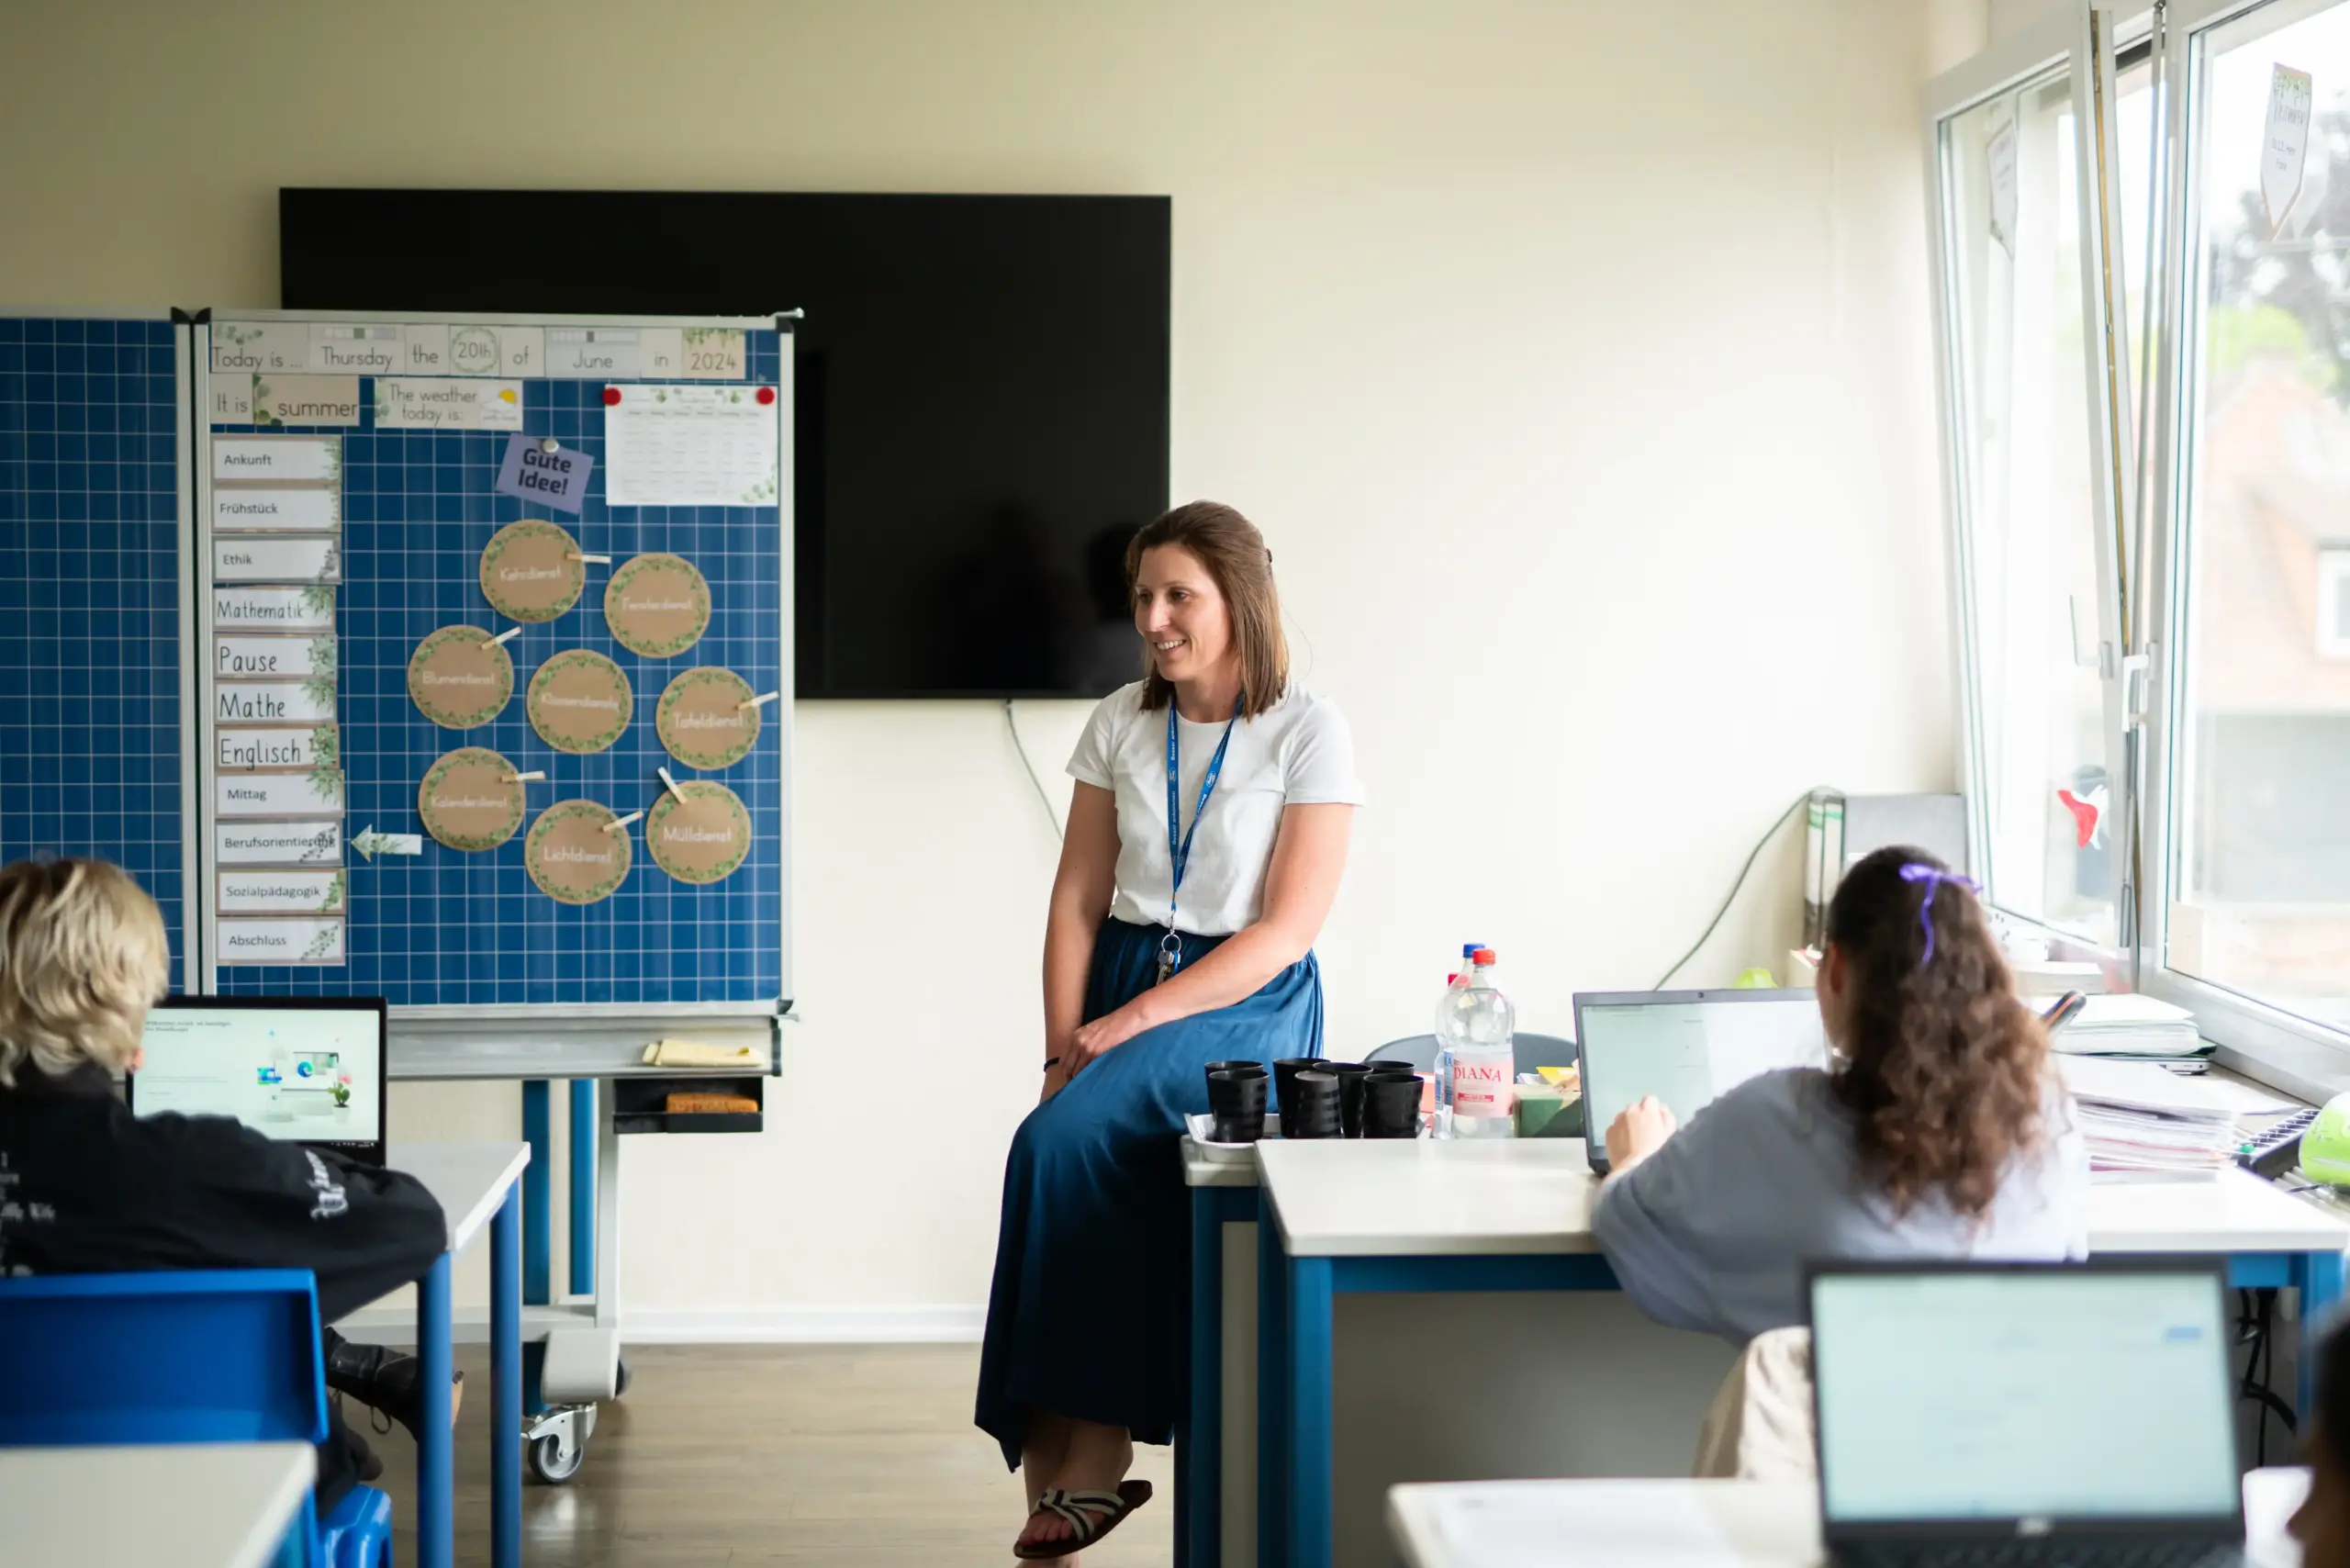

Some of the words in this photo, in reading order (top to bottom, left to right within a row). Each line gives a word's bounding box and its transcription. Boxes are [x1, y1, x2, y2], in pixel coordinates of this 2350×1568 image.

[213, 346, 263, 373] Today
[270, 351, 284, 367] is
[321, 346, 393, 372] Thursday
[412, 347, 439, 364] the
[457, 342, 492, 359] 20th
[512, 345, 530, 365] of
[573, 347, 613, 369] June
[654, 352, 668, 367] in
[690, 353, 737, 371] 2024
[389, 385, 414, 402] The
[419, 386, 478, 403] weather
[217, 393, 228, 412] It
[235, 397, 249, 413] is
[277, 402, 358, 418] summer
[402, 407, 442, 428] today
[224, 454, 273, 466] Ankunft
[523, 448, 572, 474] Gute
[519, 468, 568, 496] Idee!
[219, 502, 279, 515] Frühstück
[223, 554, 253, 566] Ethik
[217, 599, 306, 620] Mathematik
[219, 645, 277, 673] Pause
[219, 692, 285, 718] Mathe
[220, 737, 301, 771] Englisch
[227, 789, 267, 801] Mittag
[226, 885, 321, 900] Sozialpädagogik
[229, 935, 287, 946] Abschluss
[1453, 1066, 1502, 1082] DIANA
